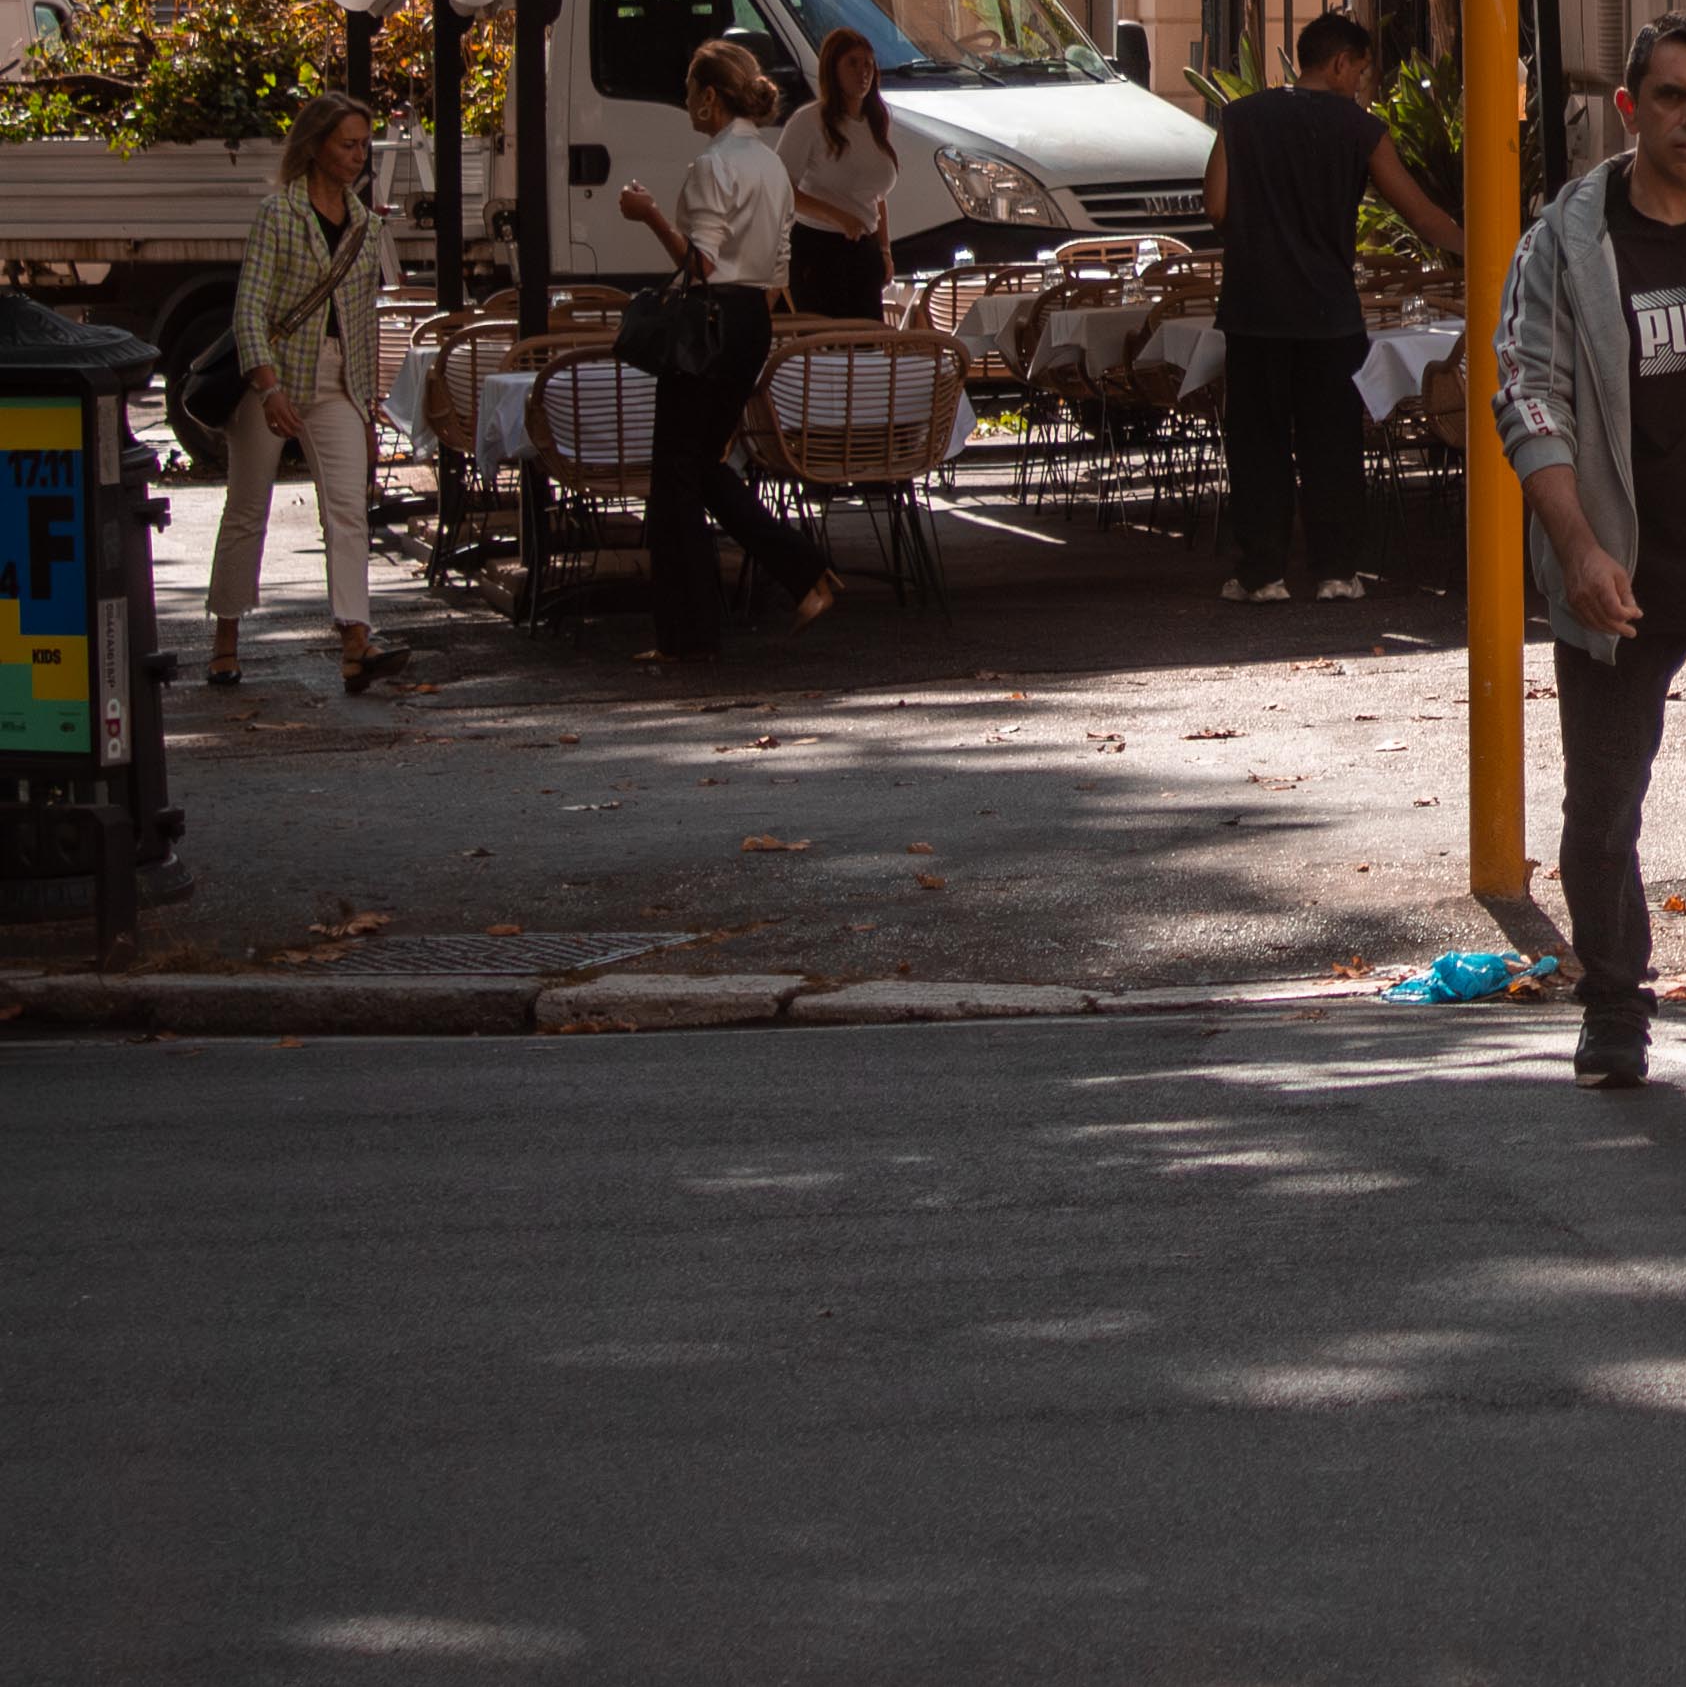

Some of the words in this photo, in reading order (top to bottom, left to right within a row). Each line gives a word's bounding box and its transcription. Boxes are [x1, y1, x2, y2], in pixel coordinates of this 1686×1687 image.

[8, 450, 74, 487] 17.11
[28, 496, 74, 600] F
[32, 649, 62, 664] KIDS
